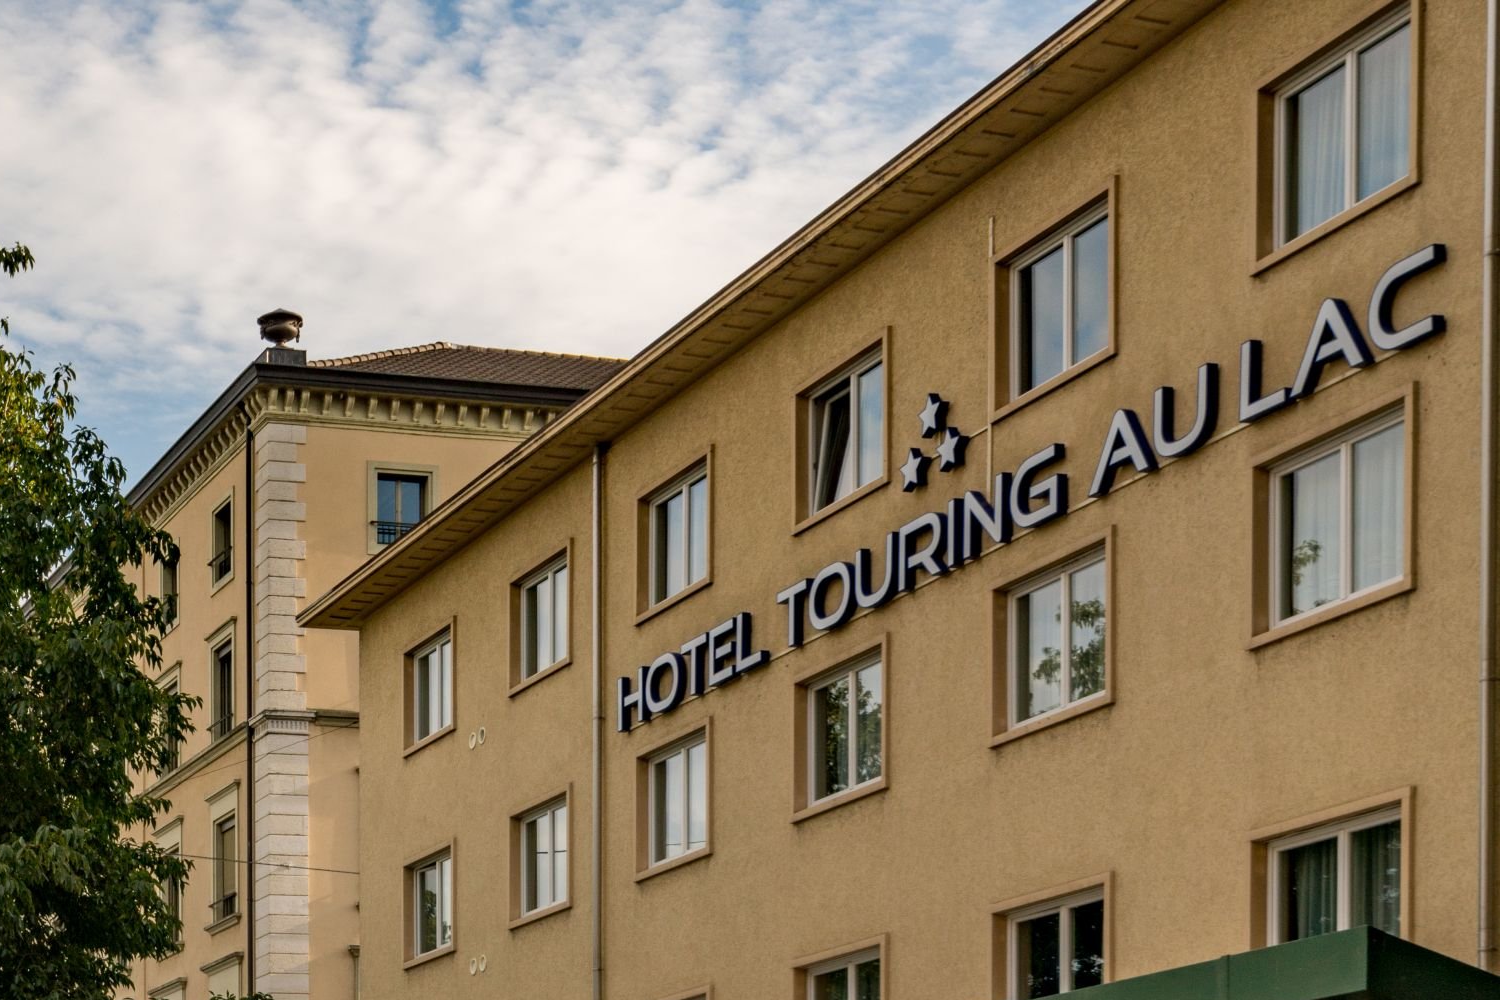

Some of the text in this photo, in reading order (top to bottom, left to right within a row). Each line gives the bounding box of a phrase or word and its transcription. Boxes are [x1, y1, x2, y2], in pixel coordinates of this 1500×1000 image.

[617, 243, 1448, 732] HOTEL TOURING AU LAC
